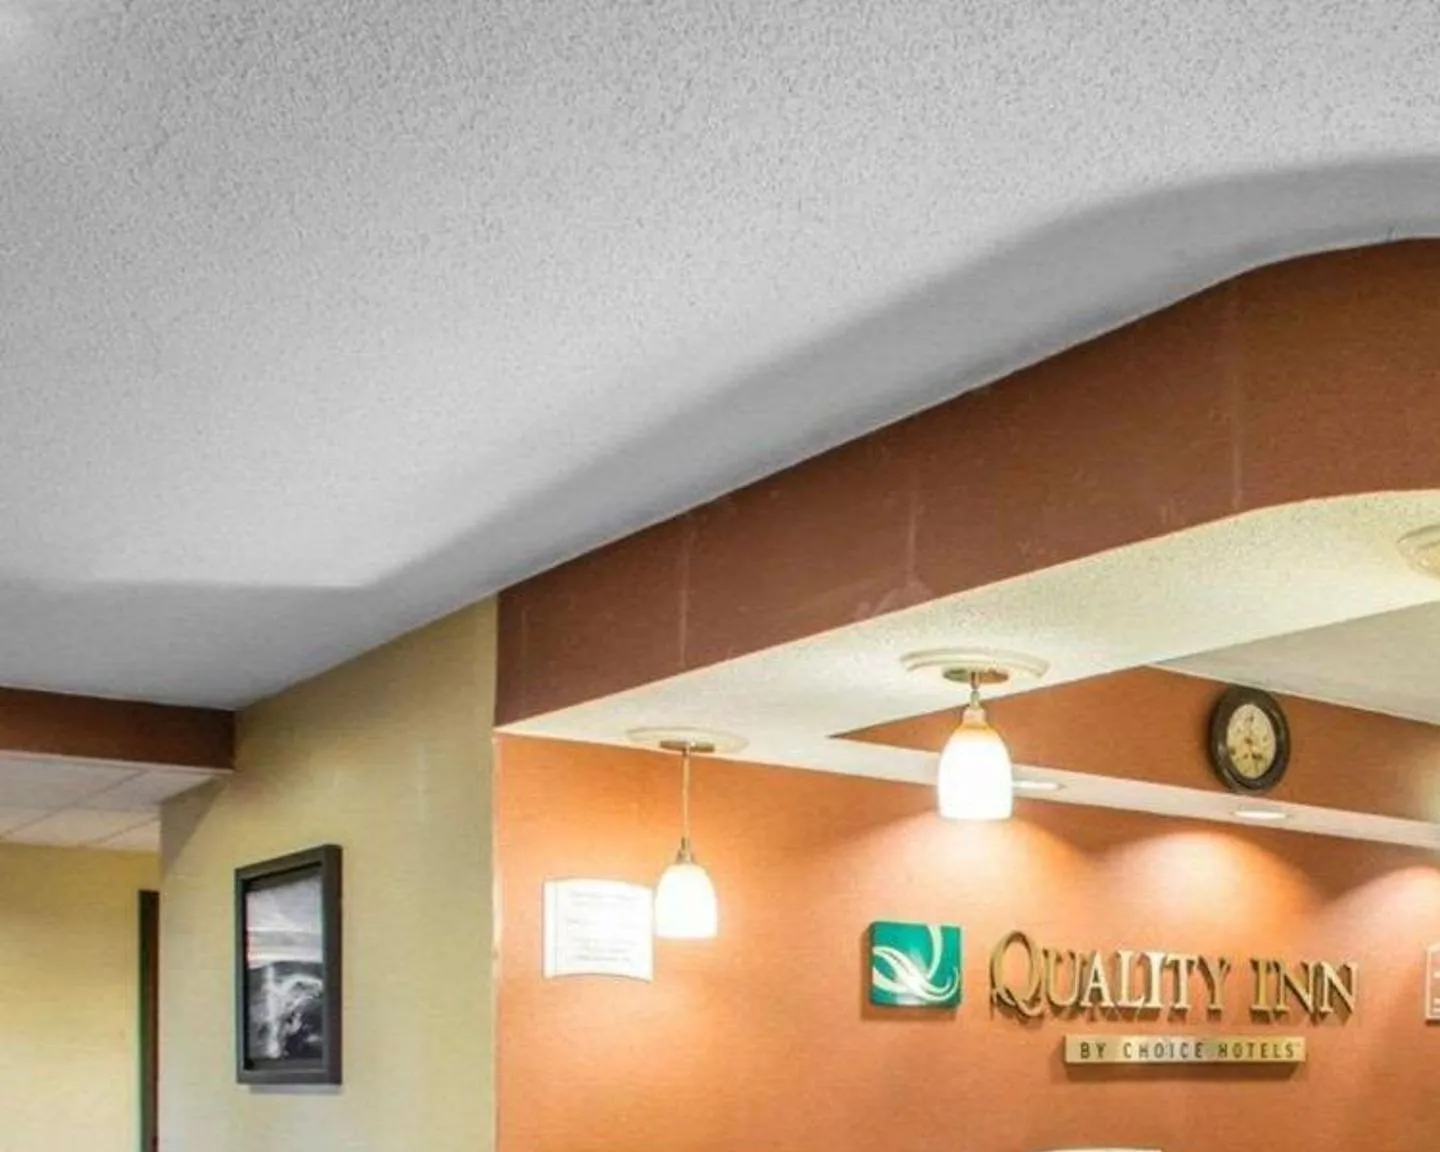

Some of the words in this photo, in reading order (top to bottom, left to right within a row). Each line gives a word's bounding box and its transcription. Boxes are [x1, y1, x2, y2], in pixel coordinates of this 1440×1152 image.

[989, 930, 1230, 1018] QUALITY
[1250, 957, 1360, 1016] INN
[1079, 1040, 1107, 1060] BY
[1122, 1040, 1204, 1060] CHOICE
[1217, 1040, 1296, 1060] HOTELS
